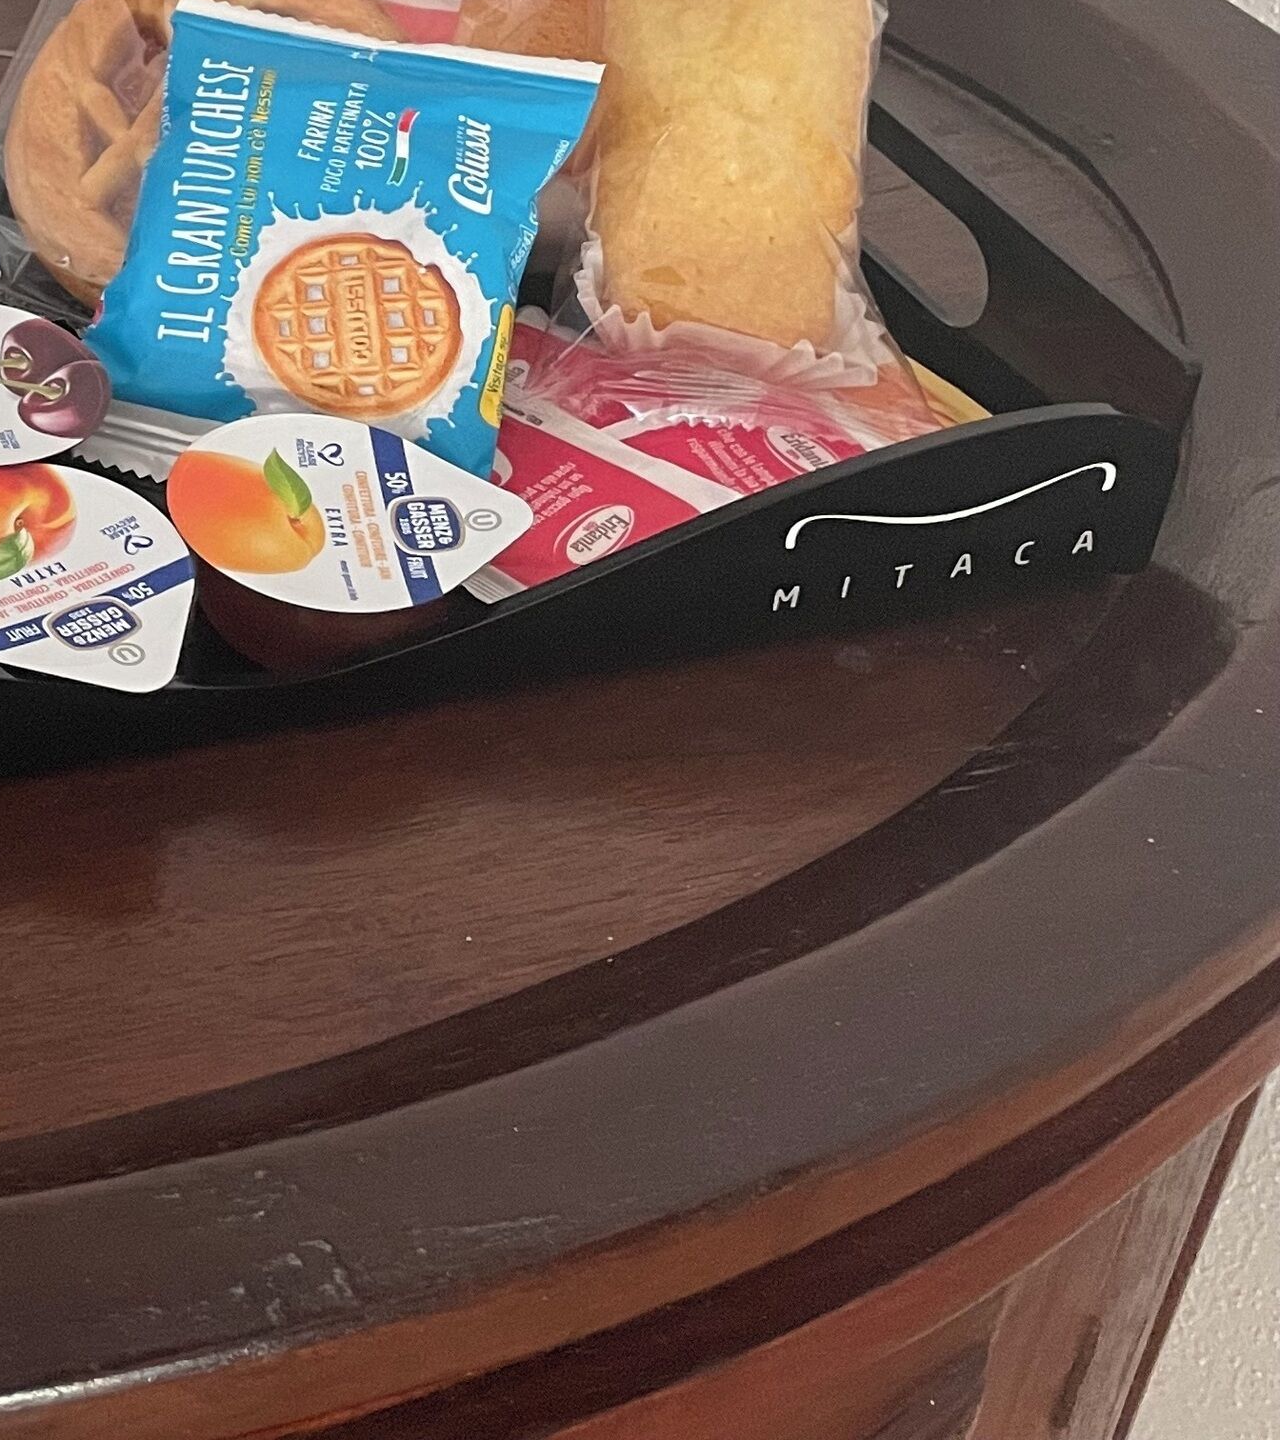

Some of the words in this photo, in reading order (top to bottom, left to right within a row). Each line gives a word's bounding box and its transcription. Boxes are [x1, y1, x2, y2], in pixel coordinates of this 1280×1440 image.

[297, 100, 338, 161] FARINA
[332, 82, 370, 154] RAFFINATA
[354, 110, 396, 170] 100%
[156, 57, 254, 295] GRANTURCHESE
[320, 158, 347, 193] POCO
[447, 114, 492, 215] Colussi
[157, 306, 215, 343] IL
[100, 515, 137, 535] RECYCLE
[110, 522, 140, 541] PLEASE
[325, 507, 349, 548] EXTRA
[407, 502, 435, 550] GASSER
[10, 562, 67, 588] EXTRA
[406, 556, 428, 580] FRUIT
[772, 529, 1094, 613] MITACA
[8, 623, 42, 643] FRUIT
[56, 606, 124, 638] GASSER
